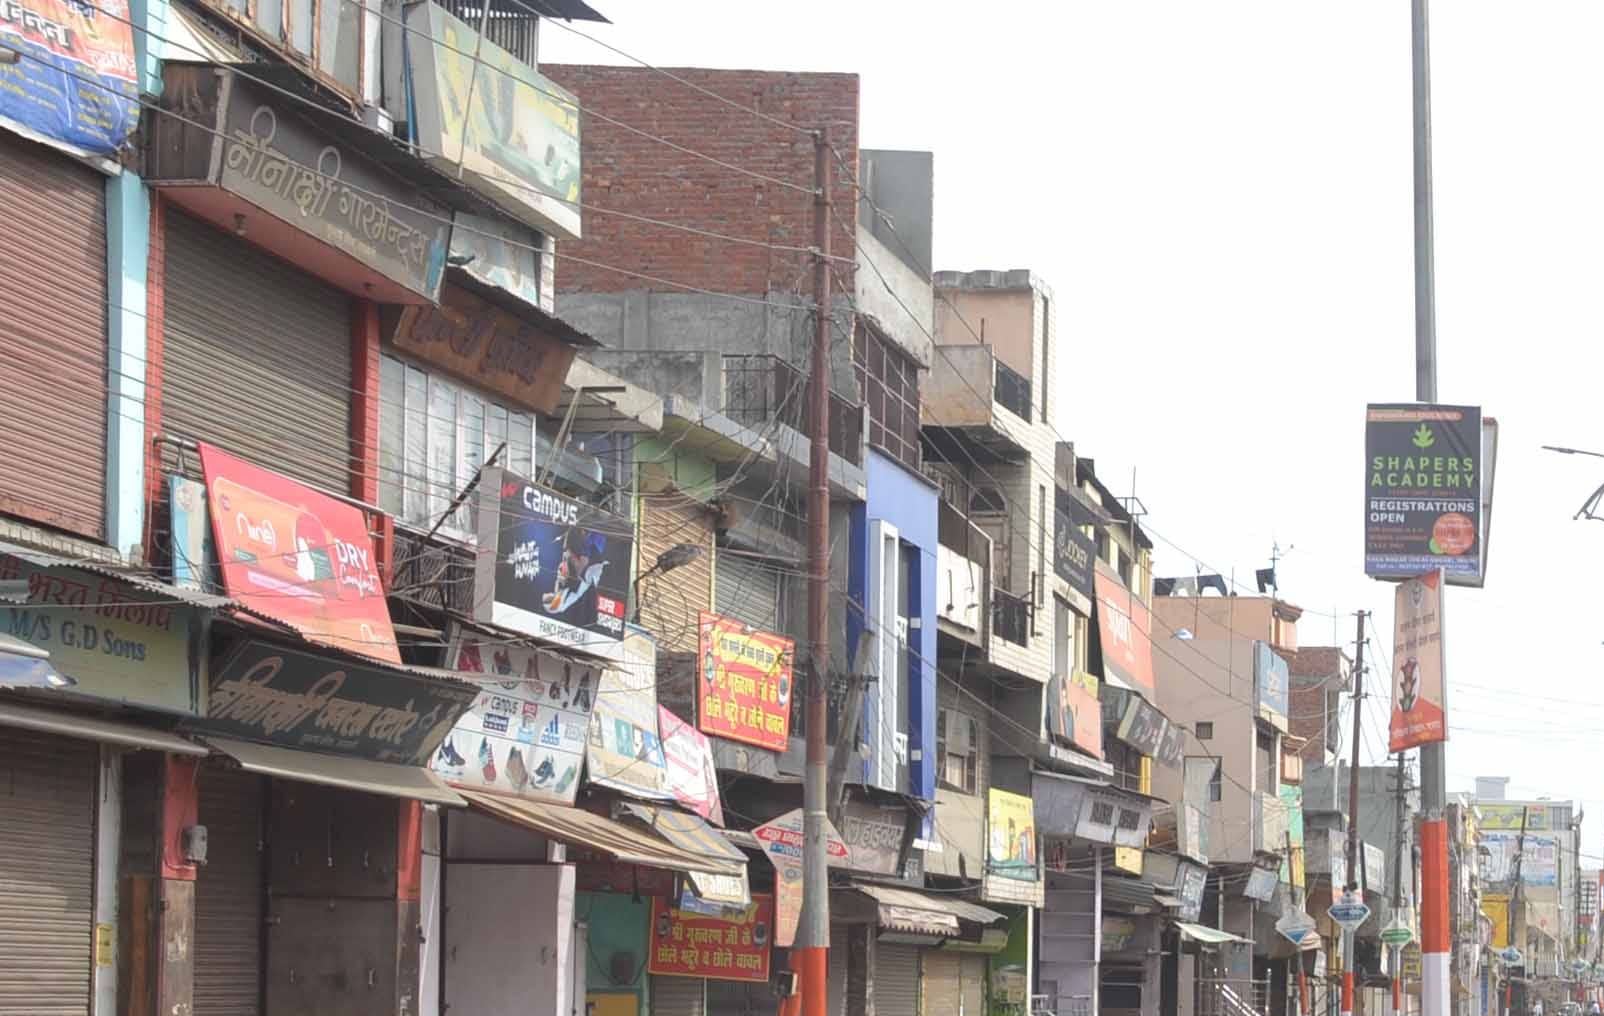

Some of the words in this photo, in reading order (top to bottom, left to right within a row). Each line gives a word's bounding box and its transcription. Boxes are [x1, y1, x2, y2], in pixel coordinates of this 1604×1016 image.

[1373, 456, 1474, 472] SHAPERS
[1371, 473, 1475, 489] ACADEMY
[1370, 500, 1475, 513] REGISTRATIONS
[1370, 513, 1406, 524] OPEN
[335, 537, 369, 572] DRY
[103, 629, 147, 662] Sons
